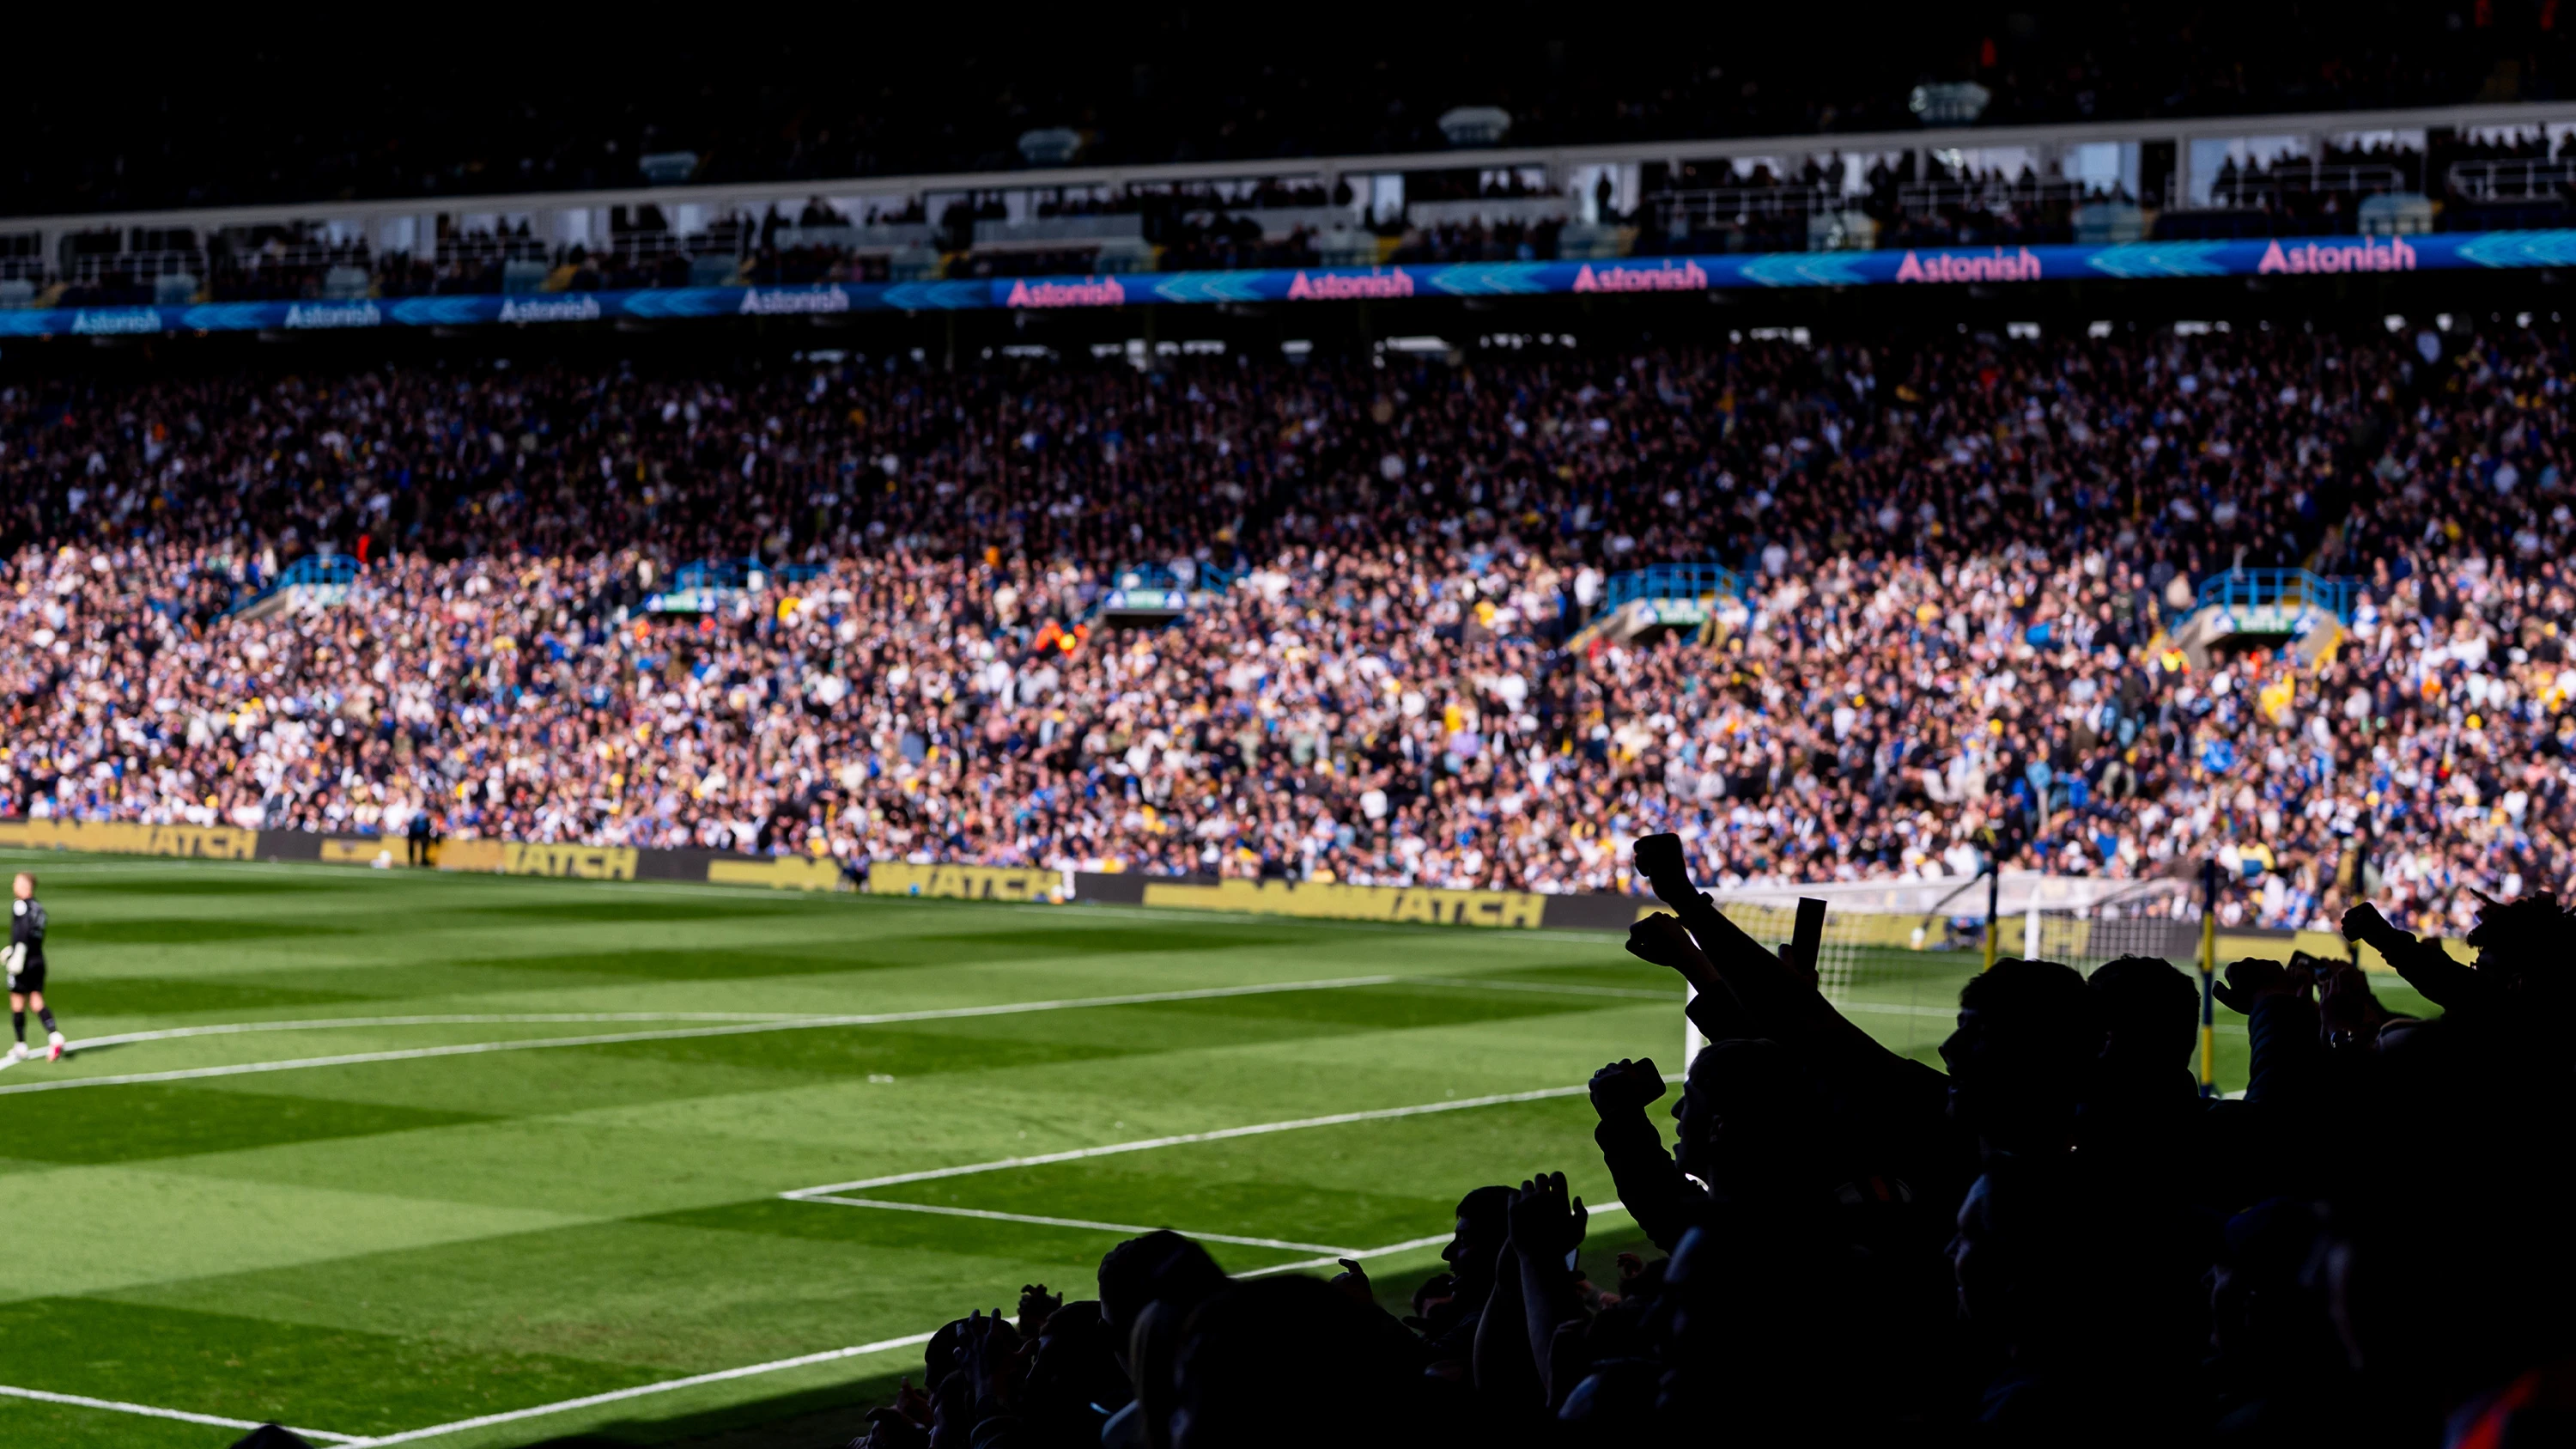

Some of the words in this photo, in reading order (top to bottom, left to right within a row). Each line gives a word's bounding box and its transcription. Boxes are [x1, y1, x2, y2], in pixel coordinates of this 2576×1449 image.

[1896, 247, 2041, 282] Astonish
[2258, 236, 2416, 273] Astonish
[1288, 267, 1413, 299] Astonish
[1574, 260, 1707, 291] Astonish
[741, 286, 849, 314] Astonish
[1007, 277, 1124, 307] Astonish
[73, 311, 161, 334] Astonish
[285, 304, 380, 327] Astonish
[499, 296, 599, 324] Astonish
